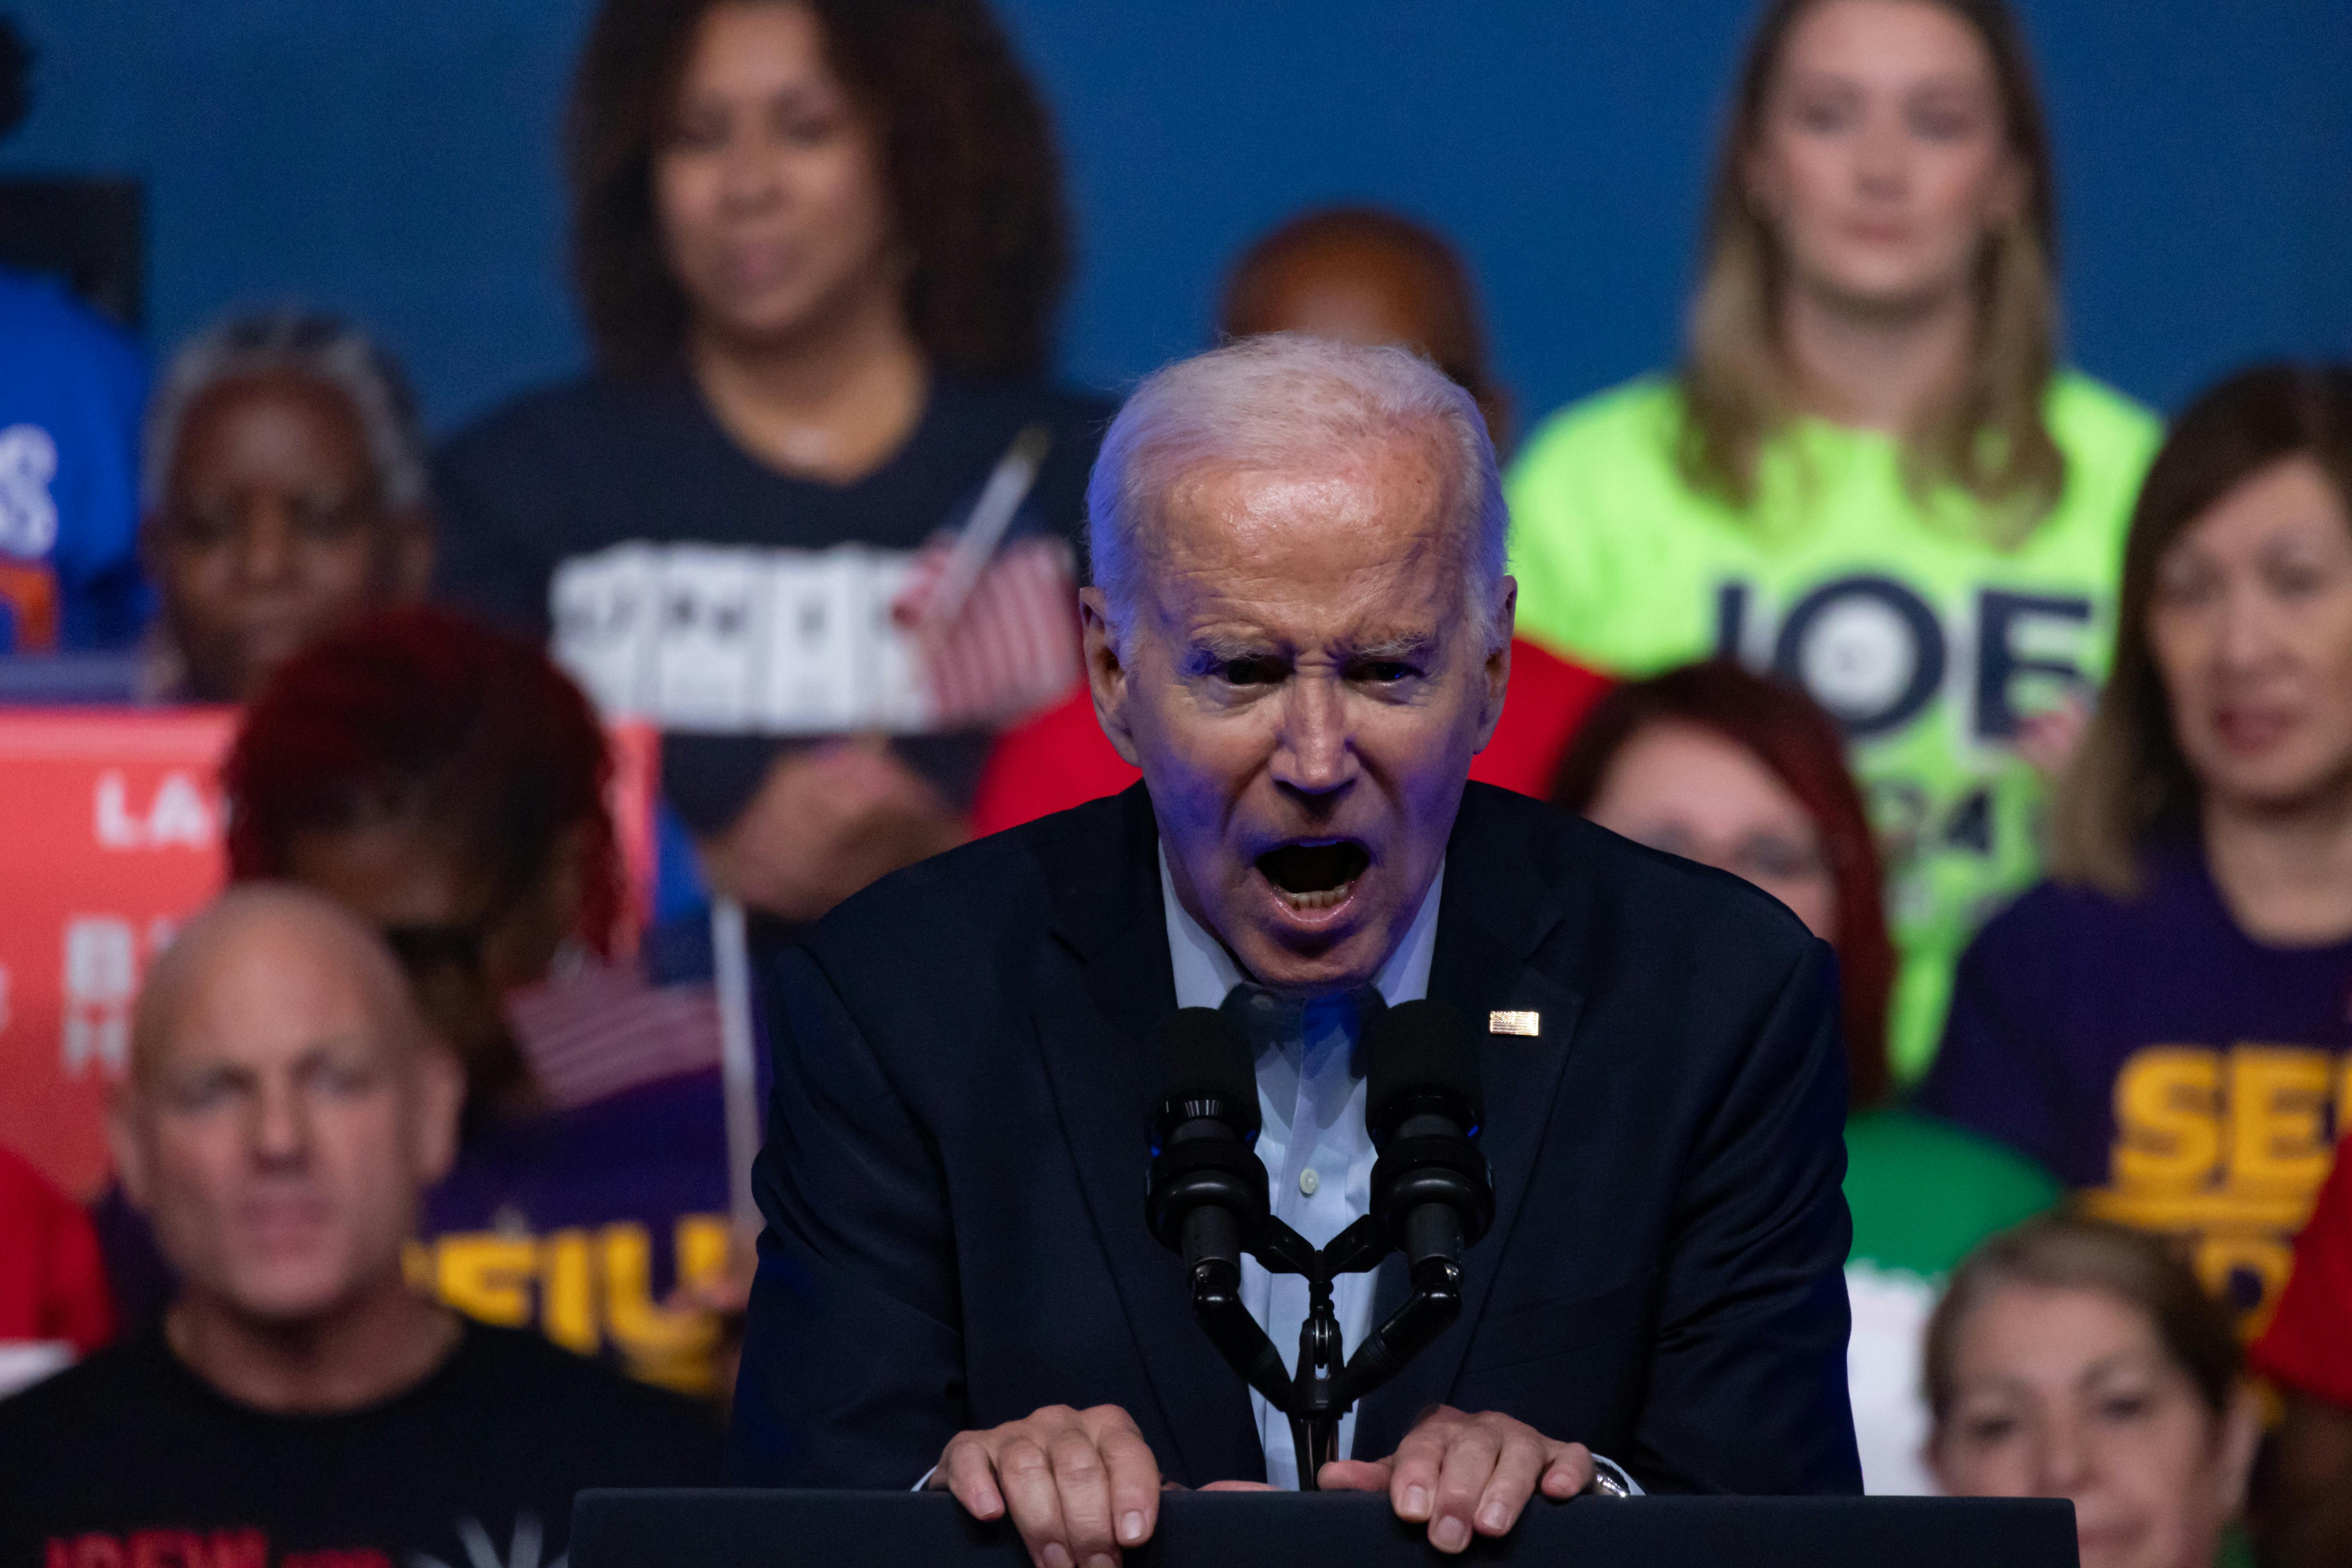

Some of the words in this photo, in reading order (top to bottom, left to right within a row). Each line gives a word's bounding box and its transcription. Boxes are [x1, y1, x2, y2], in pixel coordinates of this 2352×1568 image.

[97, 774, 232, 847] LA
[2110, 1042, 2352, 1182] SE
[402, 1214, 733, 1354] EIU
